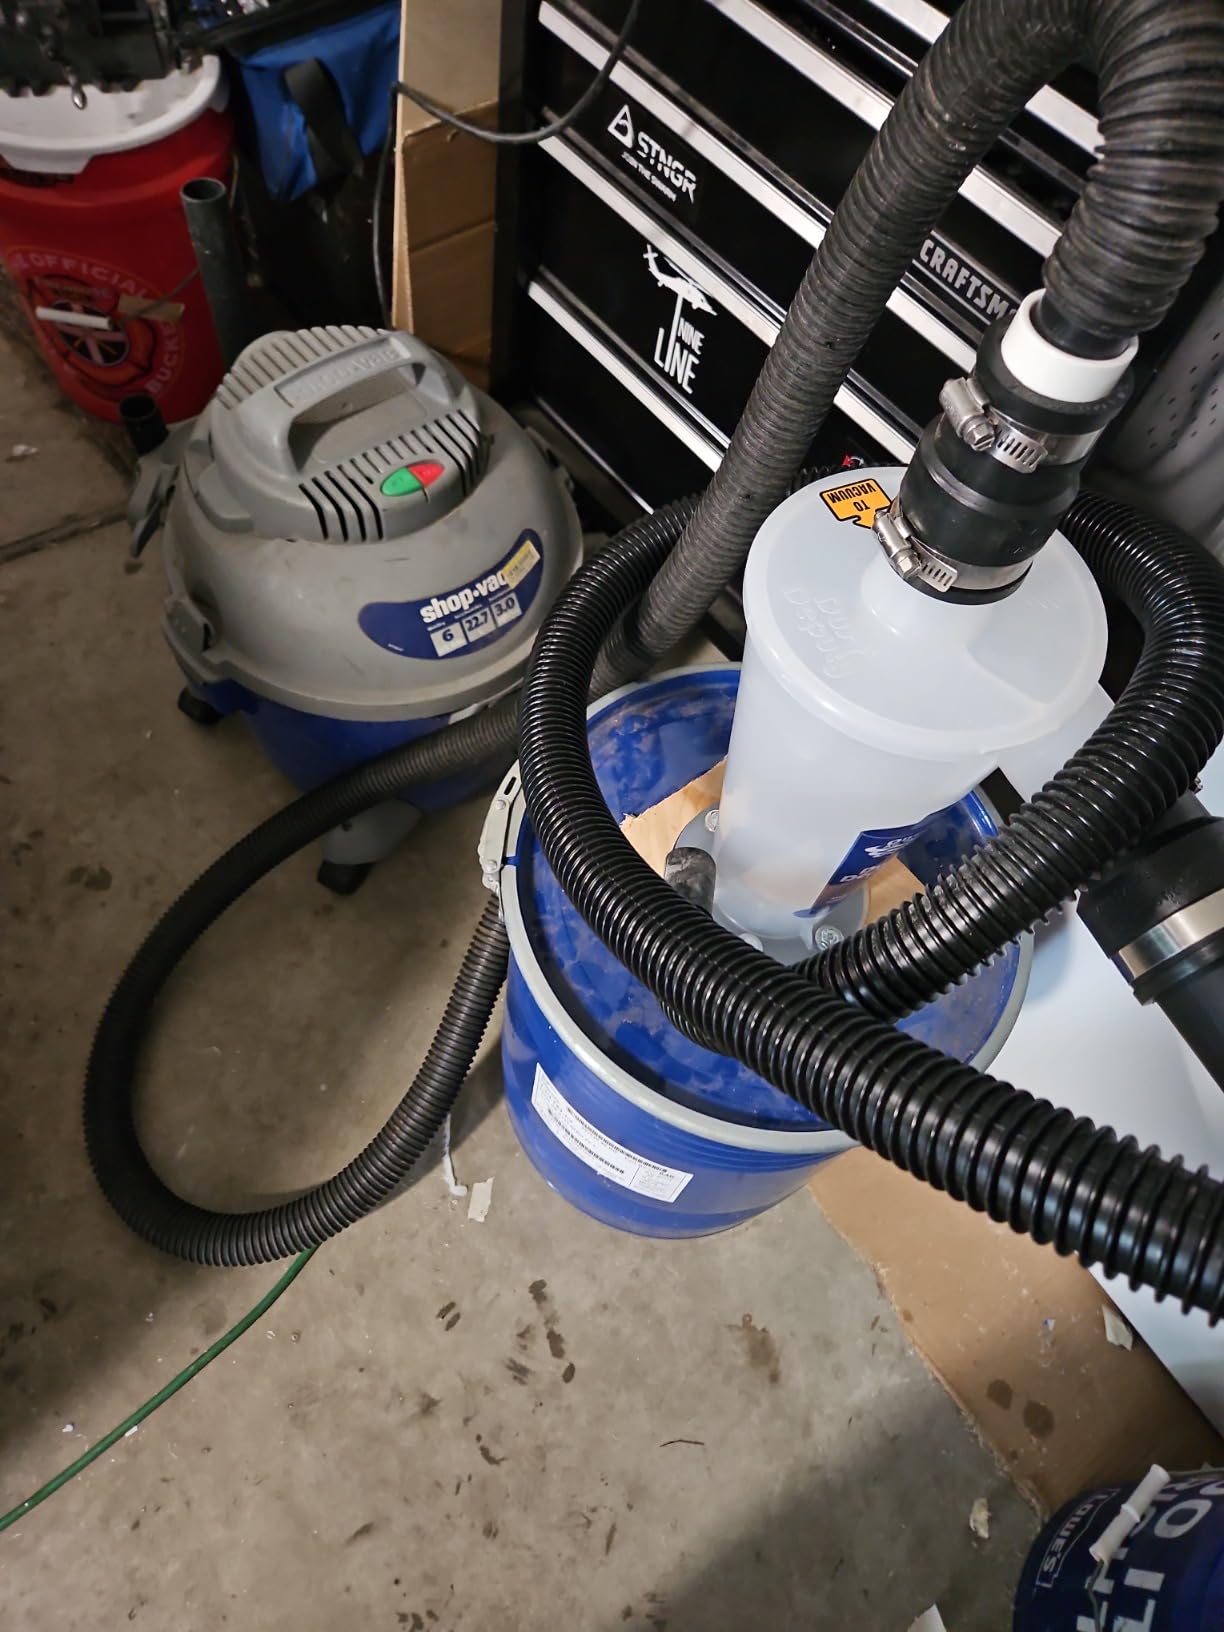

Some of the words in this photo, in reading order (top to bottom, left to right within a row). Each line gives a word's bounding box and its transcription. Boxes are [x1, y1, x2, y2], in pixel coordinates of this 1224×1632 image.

[636, 131, 696, 203] STNGR
[28, 253, 149, 298] OFFICIAL
[677, 316, 705, 355] NINE
[653, 326, 700, 394] LINE
[826, 482, 877, 504] VACUUM
[853, 500, 871, 512] TO
[494, 597, 515, 618] 3.0
[465, 611, 489, 632] 22.7
[441, 628, 454, 642] 6
